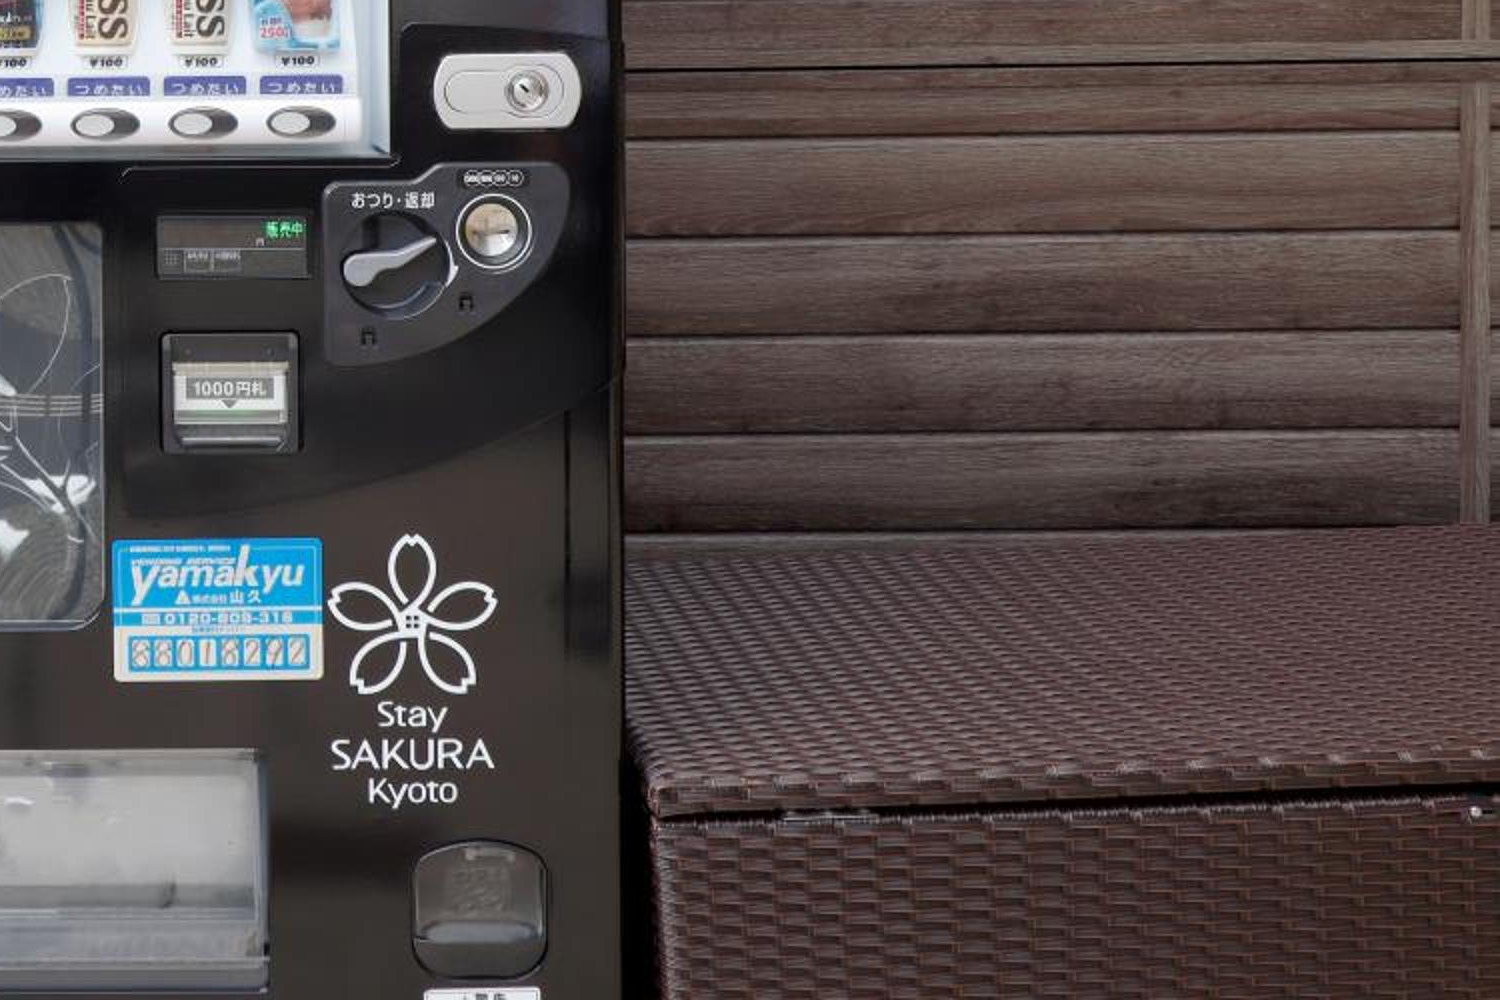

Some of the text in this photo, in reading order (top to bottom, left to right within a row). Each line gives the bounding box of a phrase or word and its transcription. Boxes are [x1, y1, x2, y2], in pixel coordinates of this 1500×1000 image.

[90, 57, 123, 67] ¥100
[185, 56, 218, 66] ¥100
[281, 55, 315, 65] ¥100
[75, 84, 143, 96] つめたい
[171, 83, 239, 96] つめたい
[267, 82, 337, 95] つめたい
[351, 191, 435, 209] おつり・返却
[192, 381, 268, 397] 1000円札
[130, 544, 305, 607] yamakyu
[377, 700, 448, 733] Stay
[331, 738, 495, 771] SAKURA
[368, 777, 458, 809] Kyoto
